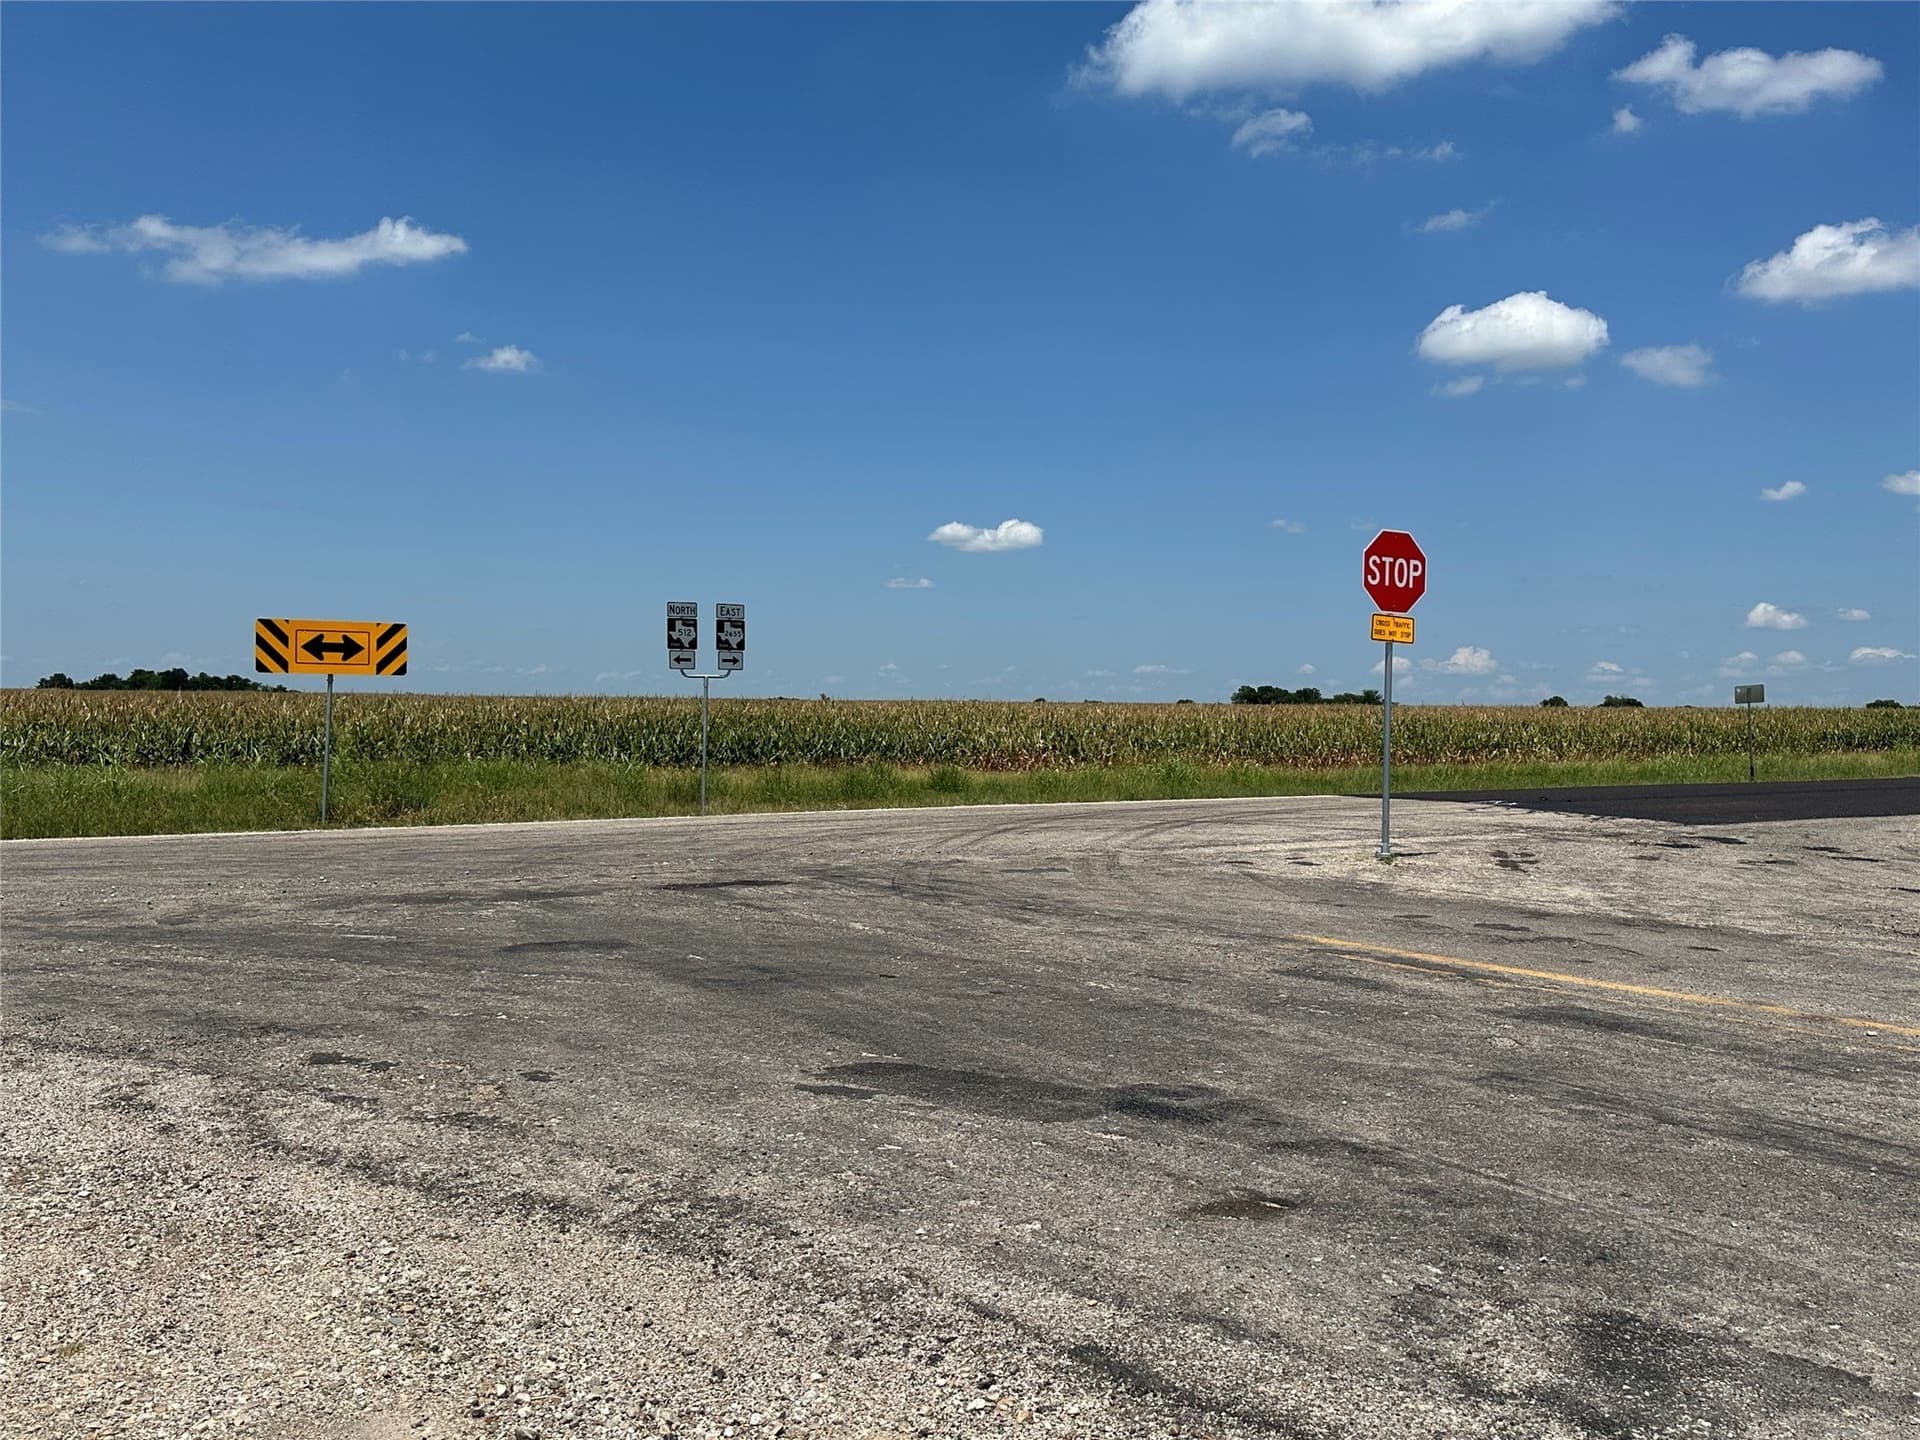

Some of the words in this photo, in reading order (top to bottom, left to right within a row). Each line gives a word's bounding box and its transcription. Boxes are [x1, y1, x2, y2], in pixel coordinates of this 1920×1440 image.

[1367, 555, 1422, 588] STOP
[669, 605, 696, 615] NORTH
[720, 606, 741, 617] EAST
[1393, 621, 1411, 629] TRAFFIC
[678, 628, 692, 637] 512
